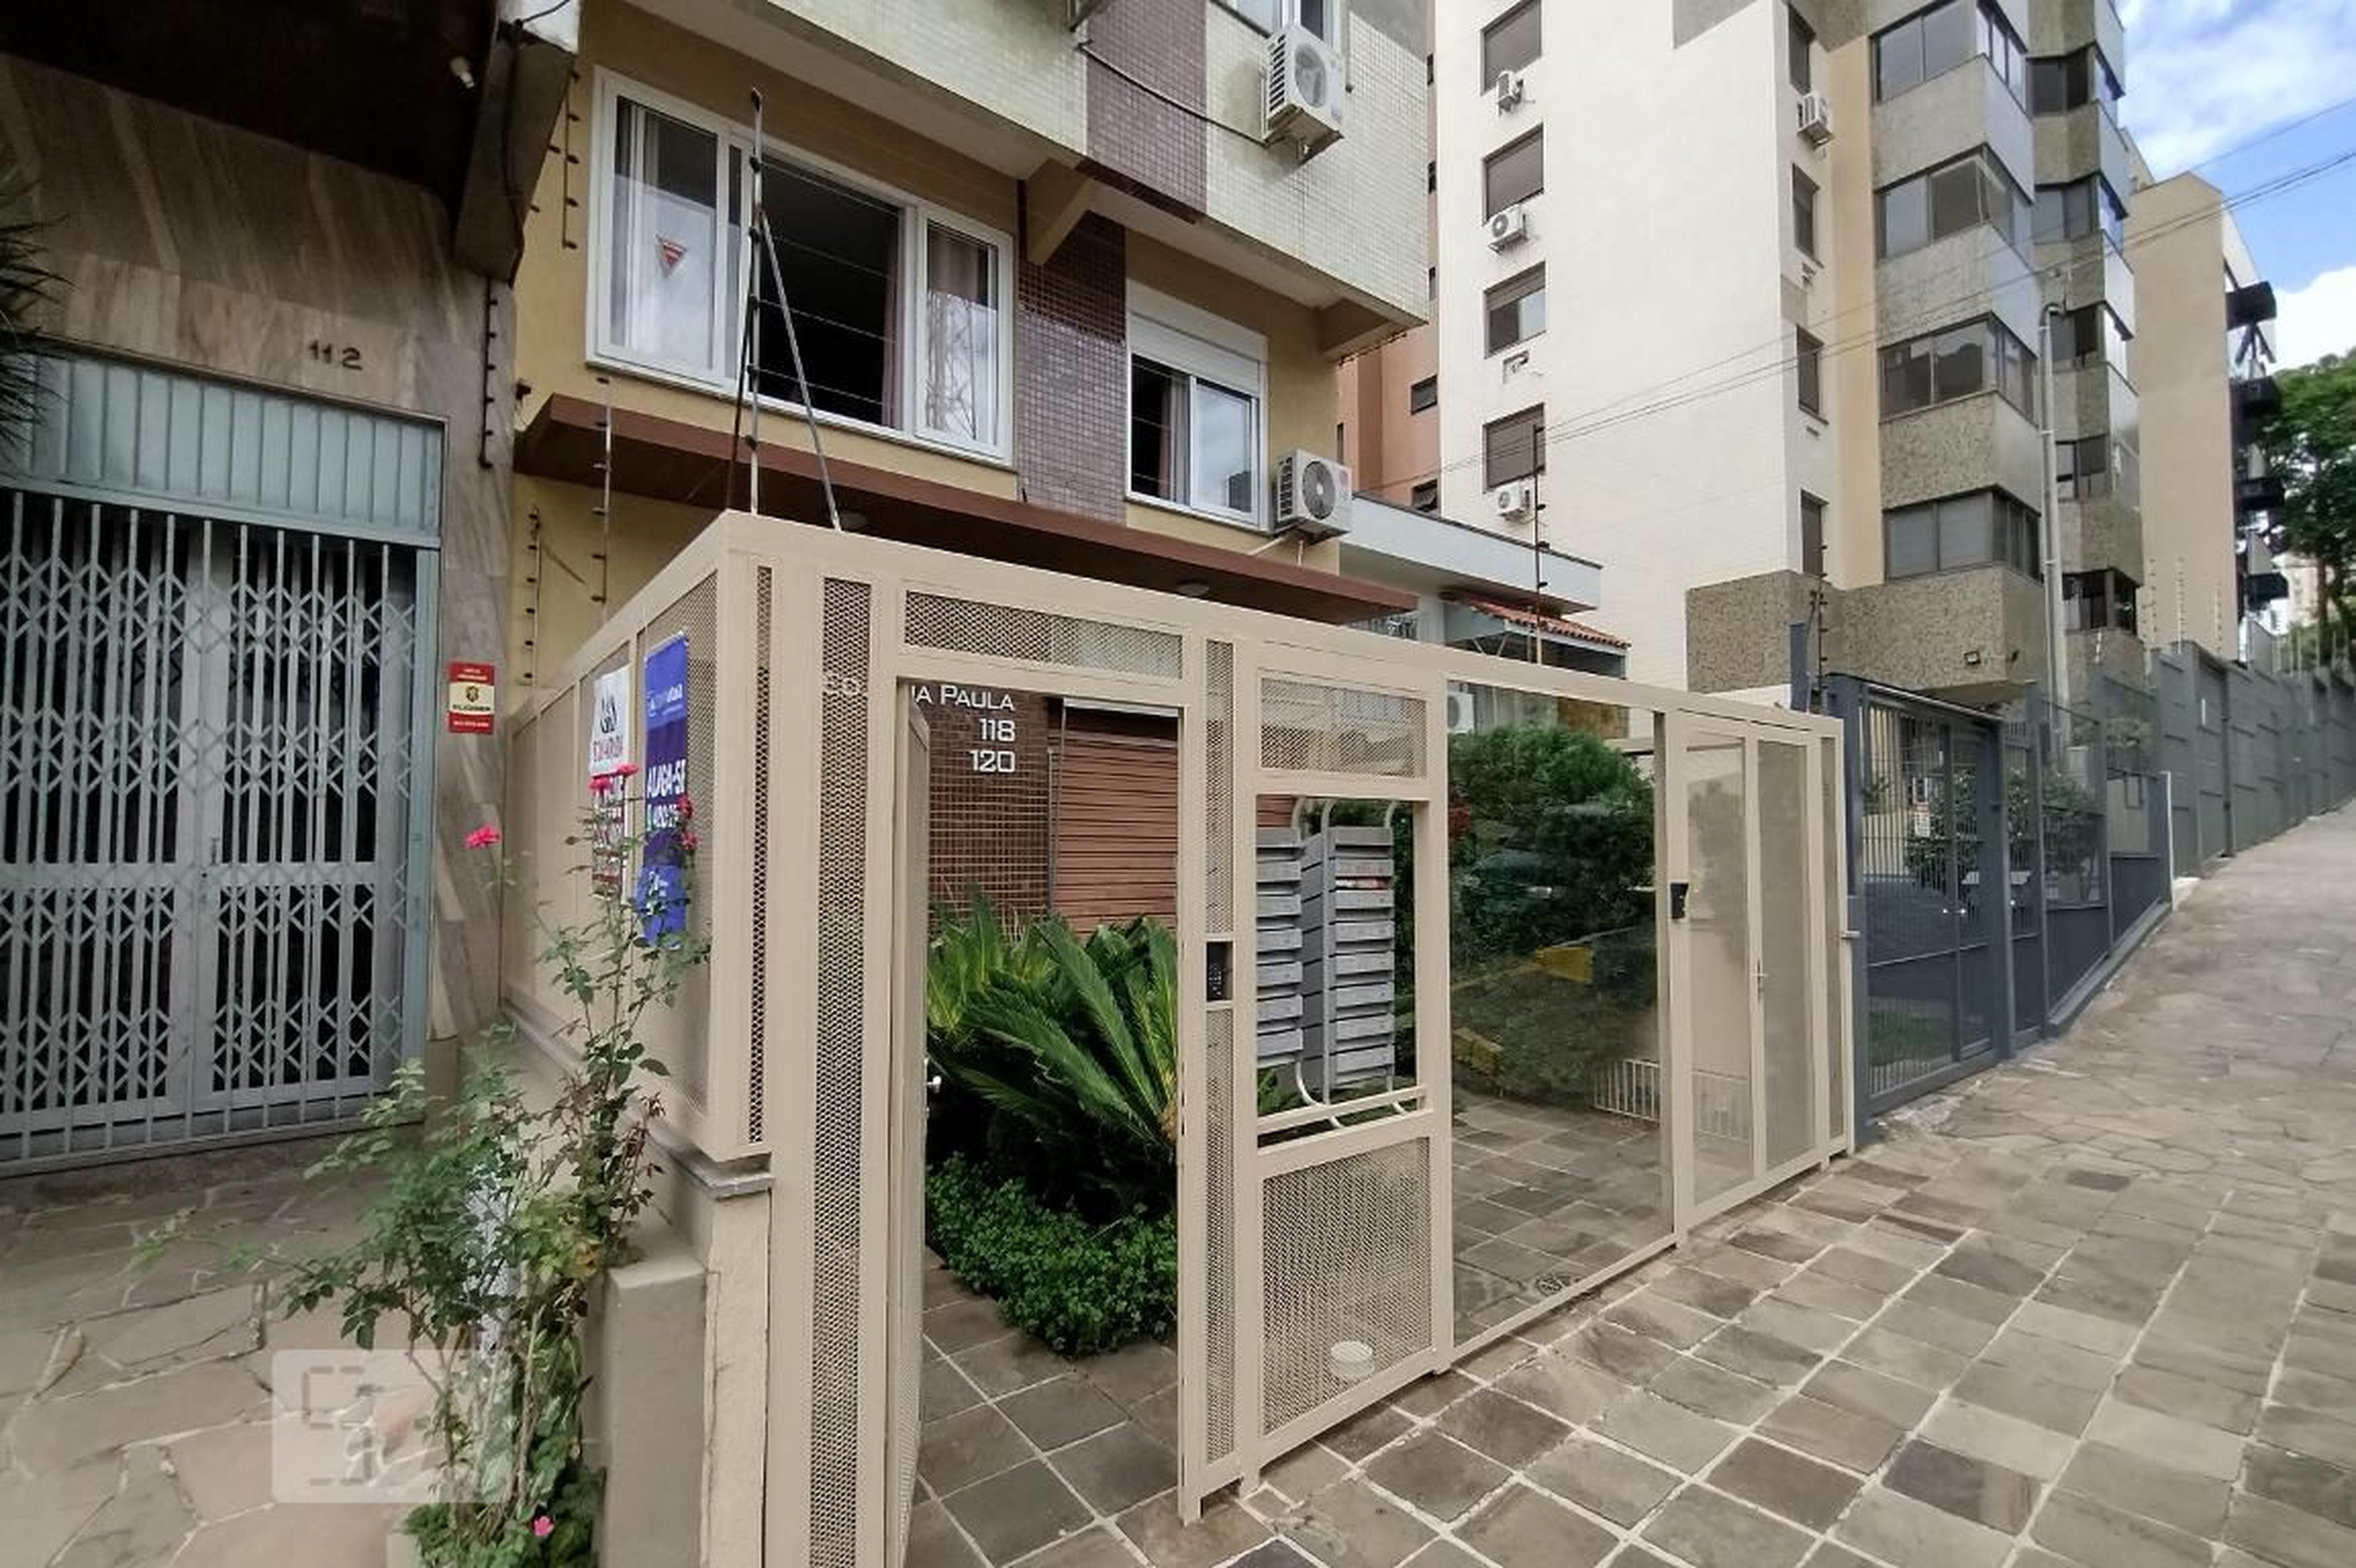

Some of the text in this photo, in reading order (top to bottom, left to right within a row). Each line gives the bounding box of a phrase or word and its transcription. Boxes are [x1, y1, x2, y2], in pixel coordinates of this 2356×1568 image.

[307, 339, 362, 371] 112
[941, 684, 1015, 711] PAULA
[979, 718, 1015, 742] 118
[969, 750, 1015, 772] 120
